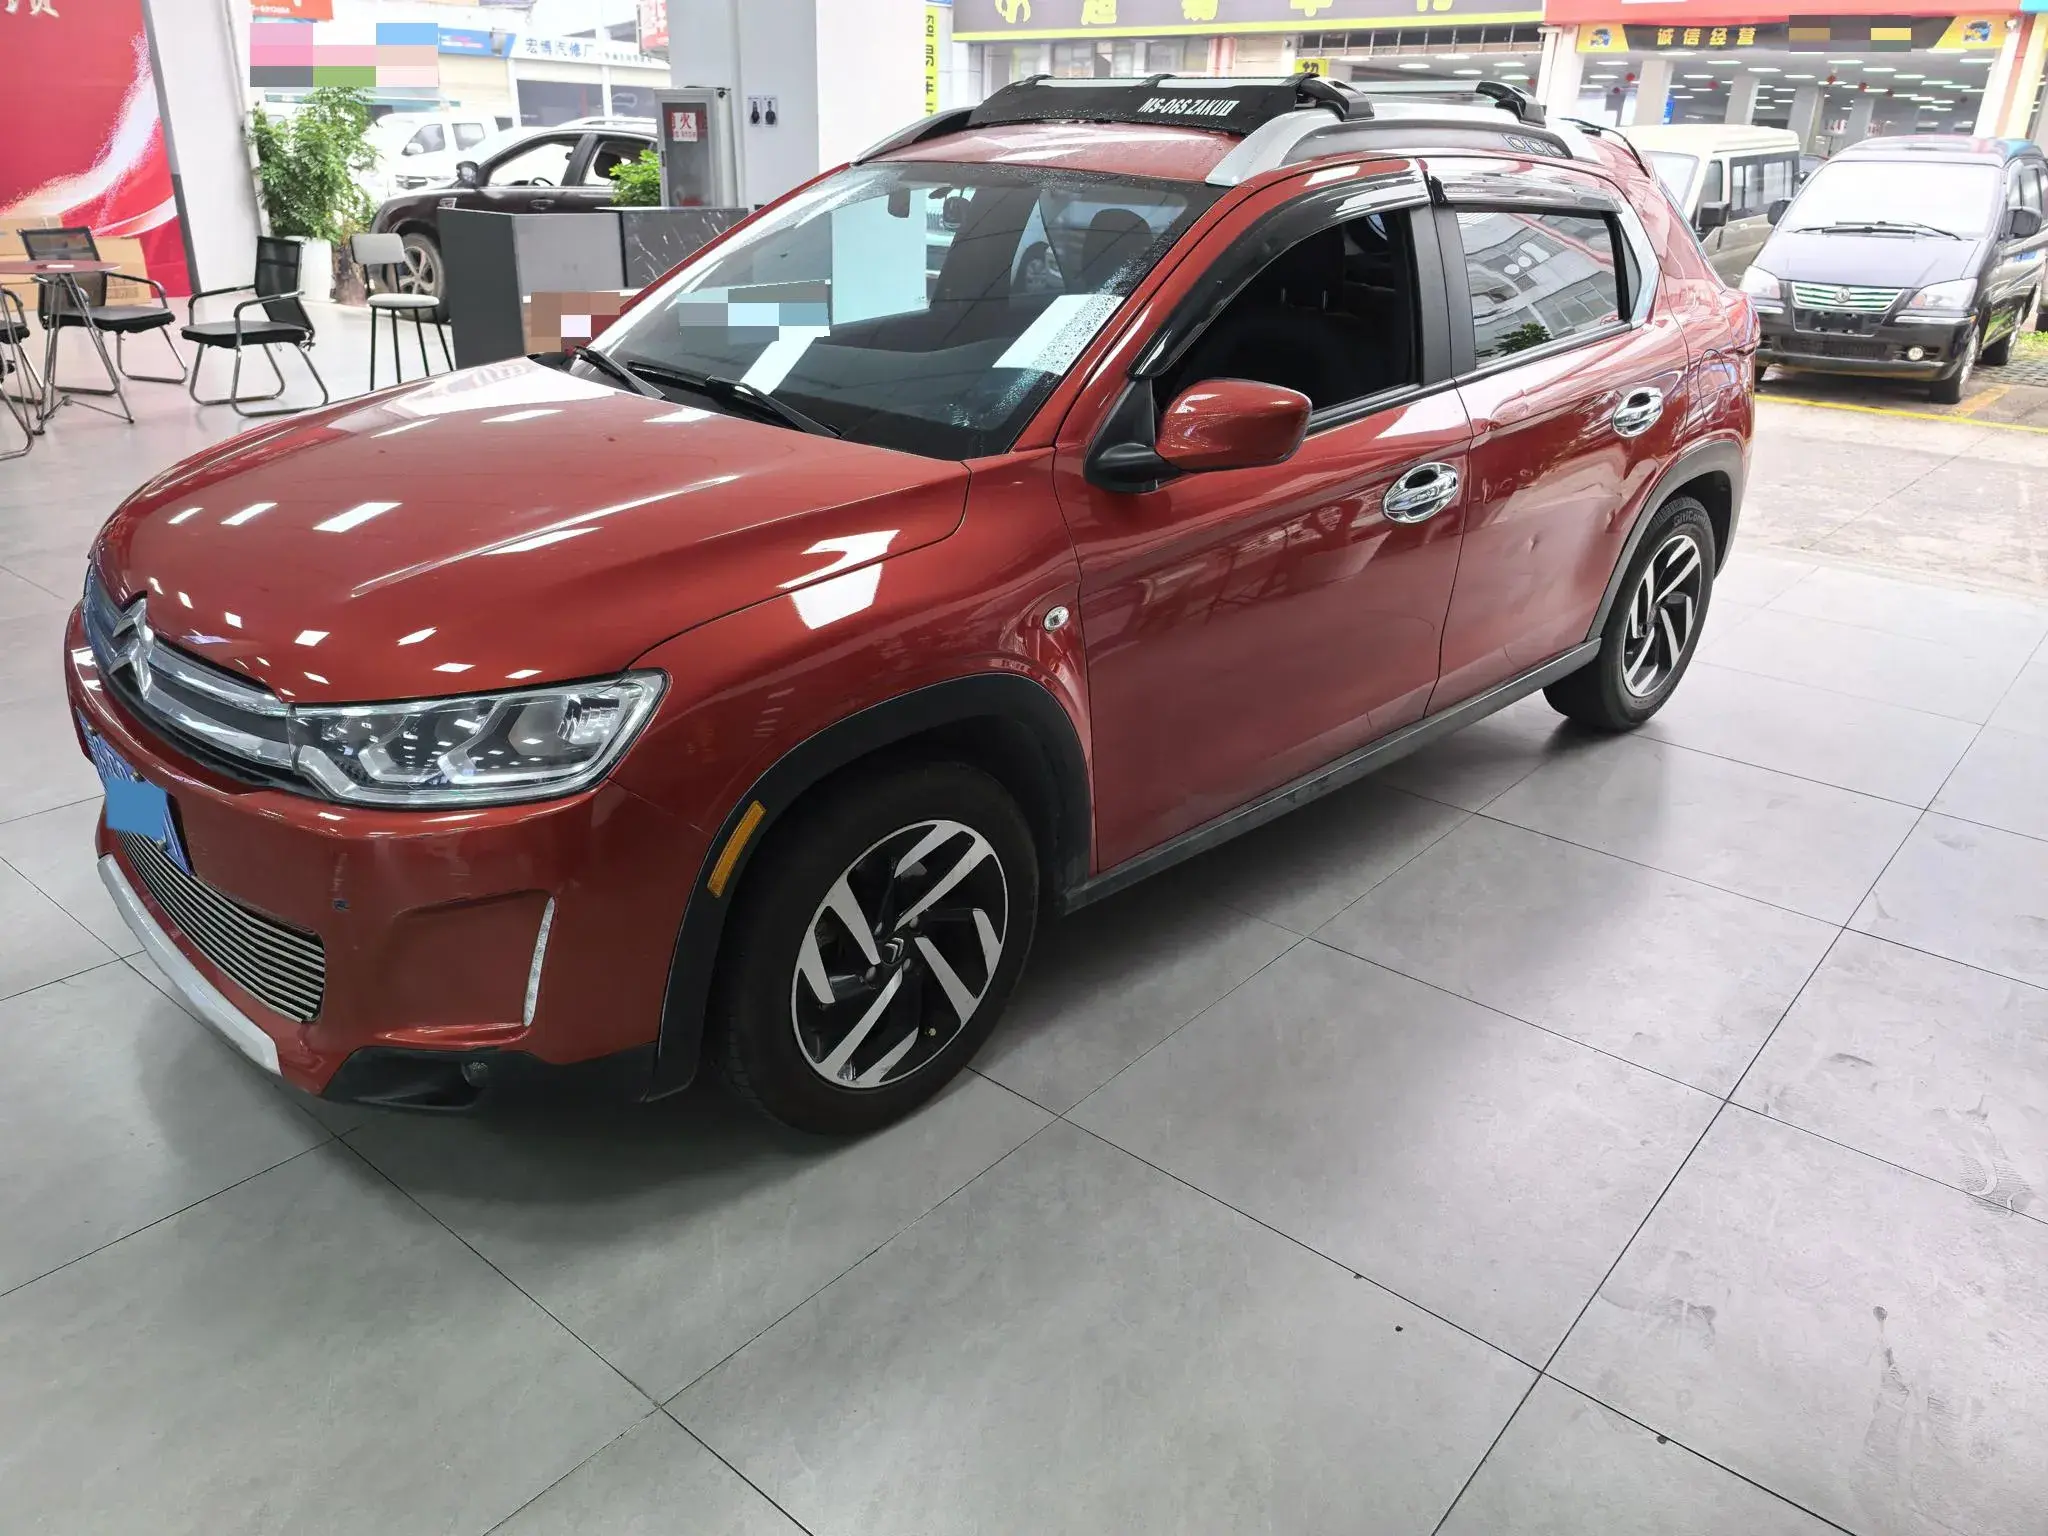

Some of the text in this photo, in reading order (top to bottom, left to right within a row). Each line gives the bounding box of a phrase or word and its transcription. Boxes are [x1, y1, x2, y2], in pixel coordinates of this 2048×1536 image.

[1657, 27, 1757, 46] 诚信经营
[525, 37, 594, 58] 宏博汽修厂
